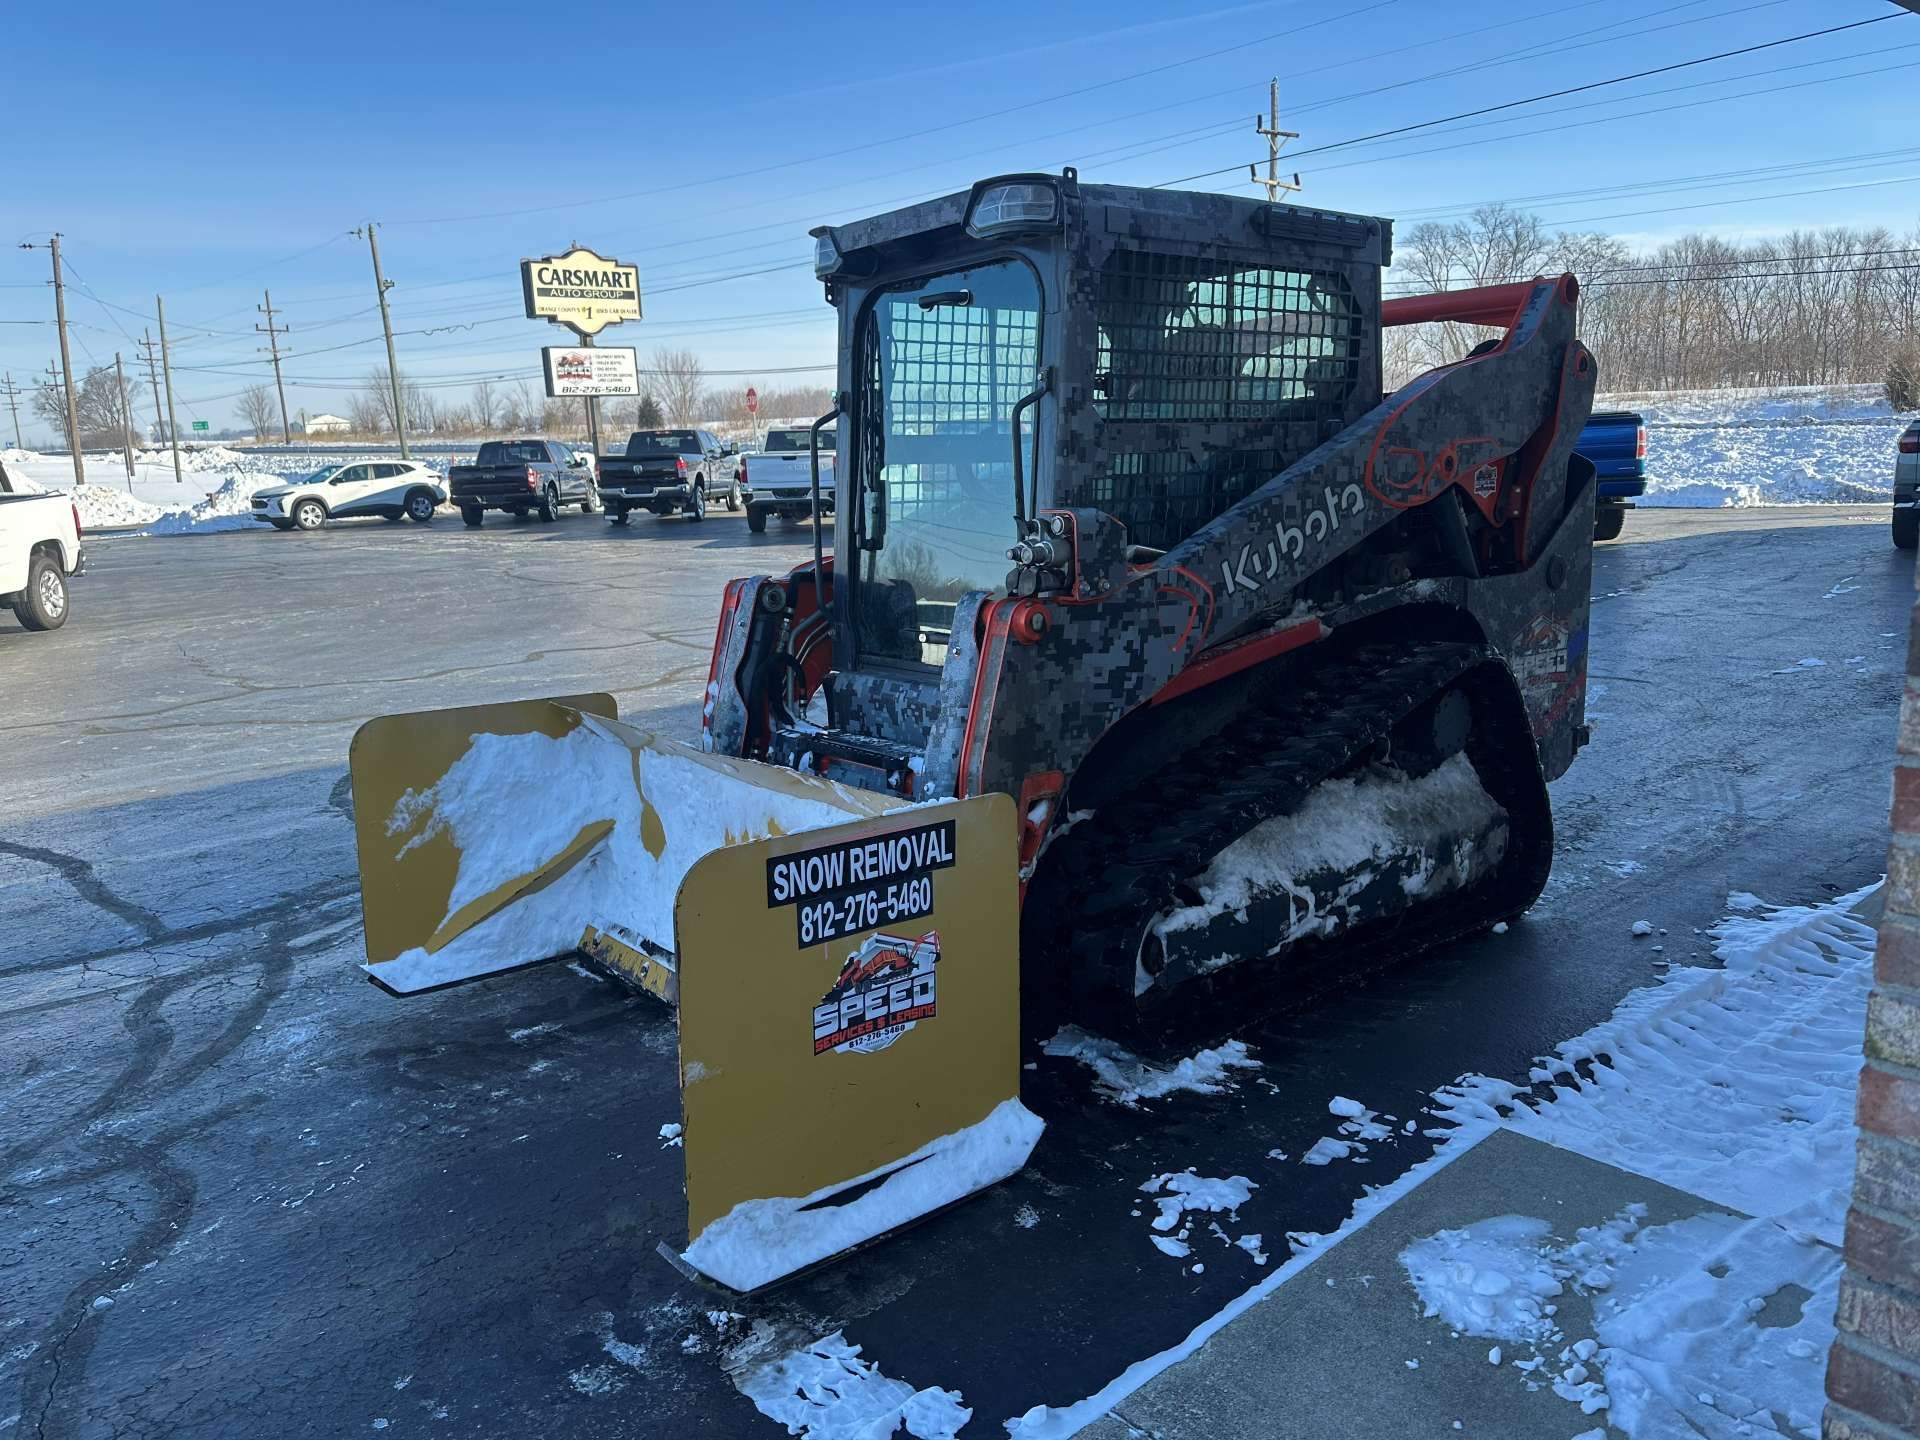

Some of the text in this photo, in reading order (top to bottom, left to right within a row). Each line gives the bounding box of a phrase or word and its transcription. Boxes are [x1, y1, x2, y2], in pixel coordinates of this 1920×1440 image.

[538, 267, 632, 288] CARSMART
[550, 288, 624, 300] AUTO GROUP
[1220, 482, 1364, 594] Kubota
[774, 828, 952, 901] SNOW REMOVAL
[802, 876, 931, 943] 812-276-5460
[814, 974, 935, 1039] SPEED
[815, 1019, 874, 1054] SERVICES
[890, 1004, 935, 1026] LEASING
[848, 1024, 906, 1049] 812-276-5460
